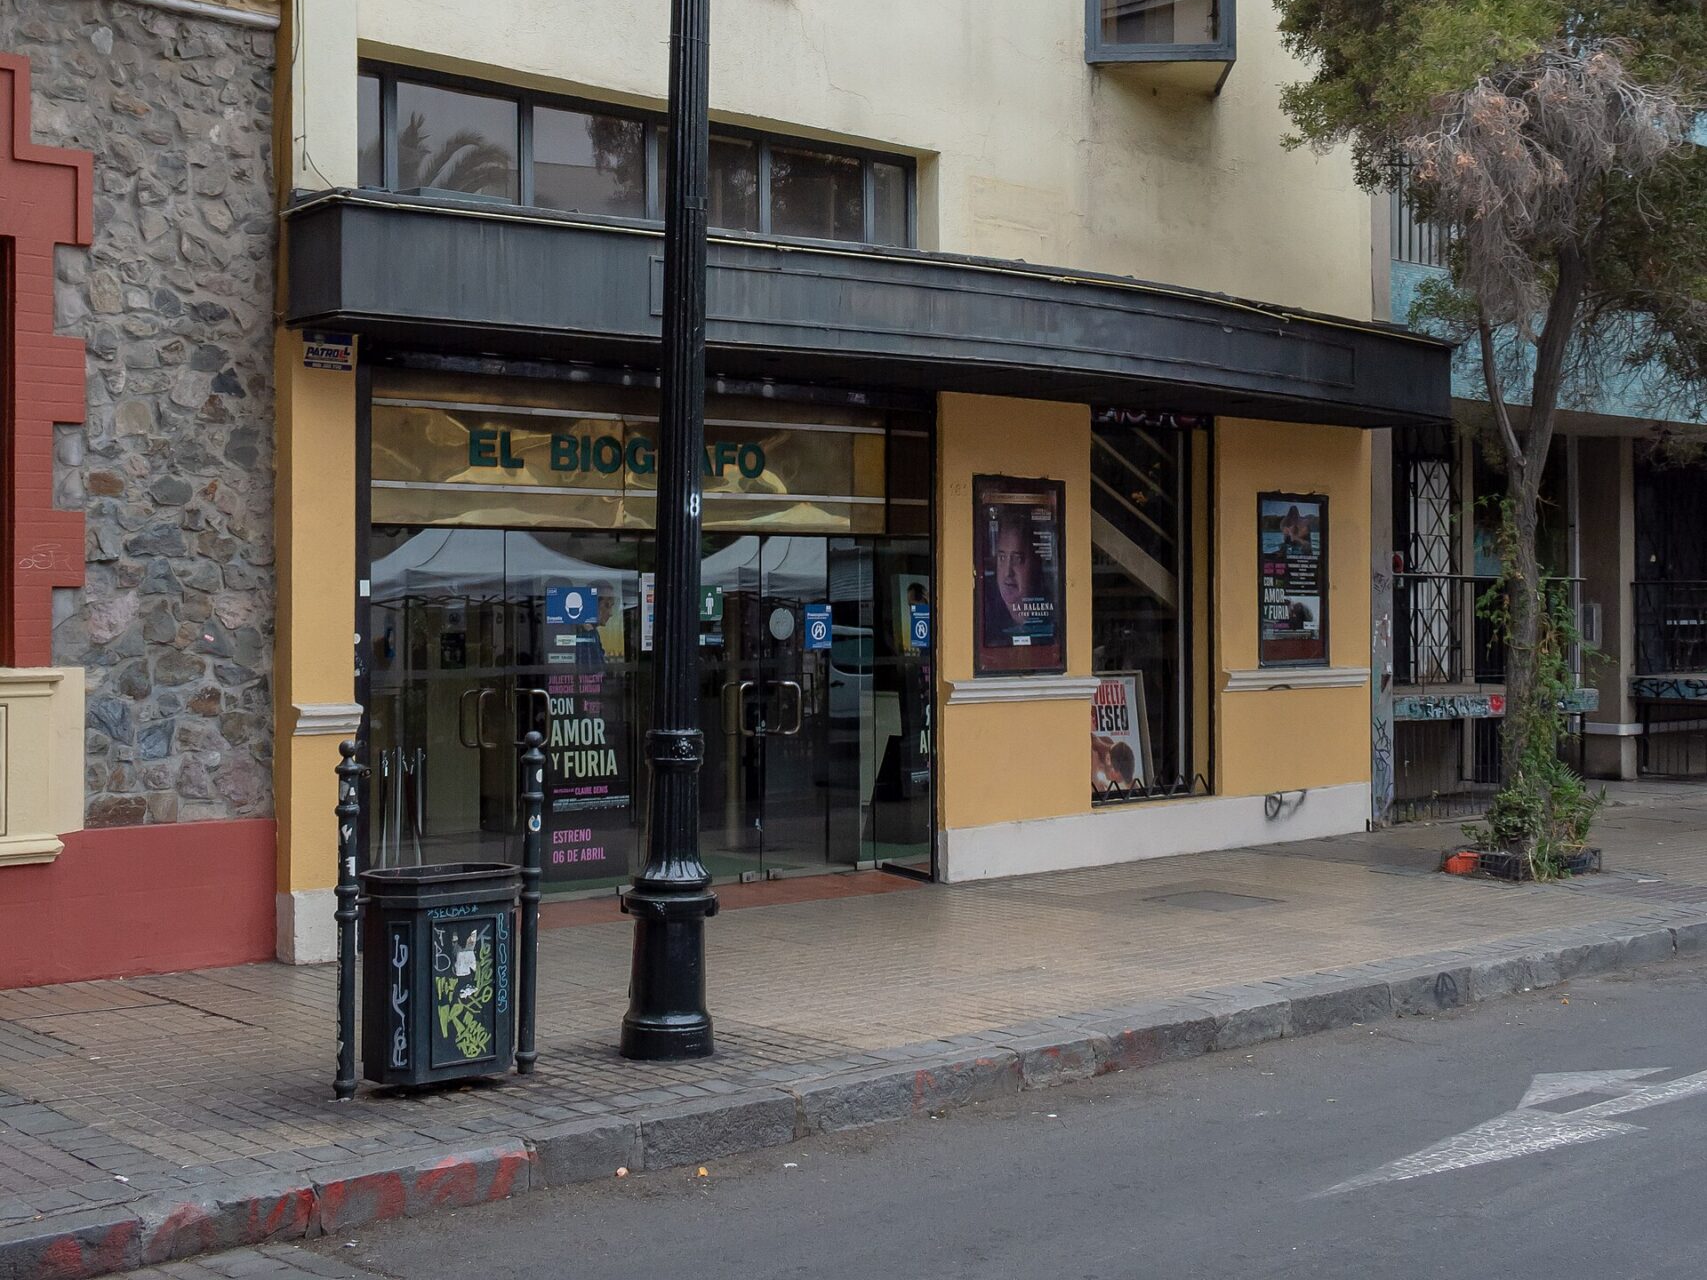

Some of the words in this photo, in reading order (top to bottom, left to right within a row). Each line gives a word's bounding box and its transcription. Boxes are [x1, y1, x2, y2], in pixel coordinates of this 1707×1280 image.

[469, 430, 524, 469] EL
[1263, 577, 1274, 586] CON
[1264, 588, 1285, 603] AMOR
[1012, 603, 1021, 611] LA
[1023, 602, 1054, 611] BALLENA
[1268, 605, 1289, 620] FURIA
[550, 698, 574, 716] CON
[550, 718, 606, 747] AMOR
[551, 753, 560, 770] Y
[564, 749, 618, 778] FURIA
[553, 828, 592, 844] ESTRENO
[553, 850, 565, 864] 06
[567, 849, 579, 862] DE
[580, 847, 606, 861] ABRIL
